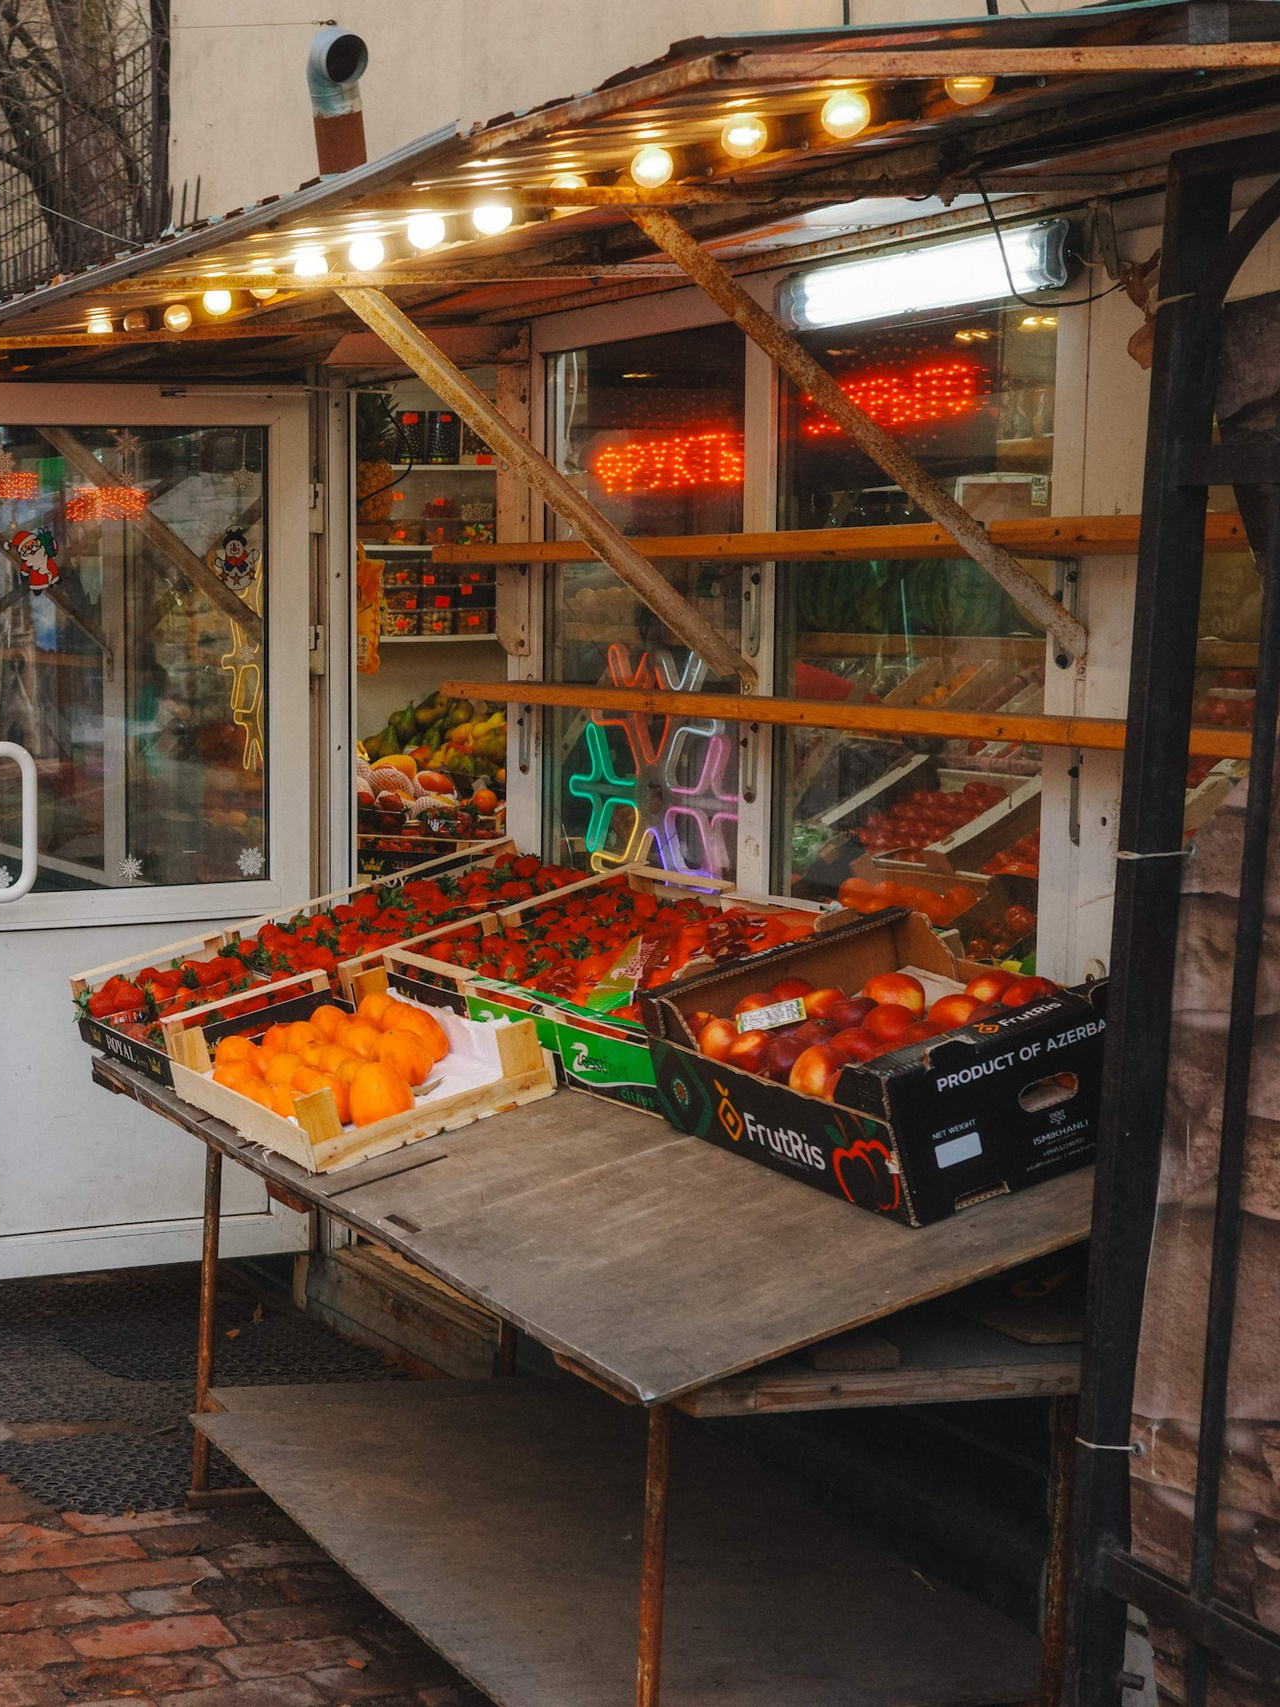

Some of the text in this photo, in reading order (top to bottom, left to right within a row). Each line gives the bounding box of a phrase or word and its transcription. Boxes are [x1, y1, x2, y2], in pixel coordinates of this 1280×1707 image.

[999, 1001, 1062, 1027] FrutRis
[105, 1033, 137, 1063] ROYAL
[936, 1052, 1015, 1092] PRODUCT
[1019, 1042, 1042, 1061] OF
[622, 1088, 654, 1108] citrus
[742, 1112, 826, 1171] FrutRis
[932, 1118, 976, 1140] NET WEIGHT
[1032, 1118, 1089, 1146] ISMIKHANLI
